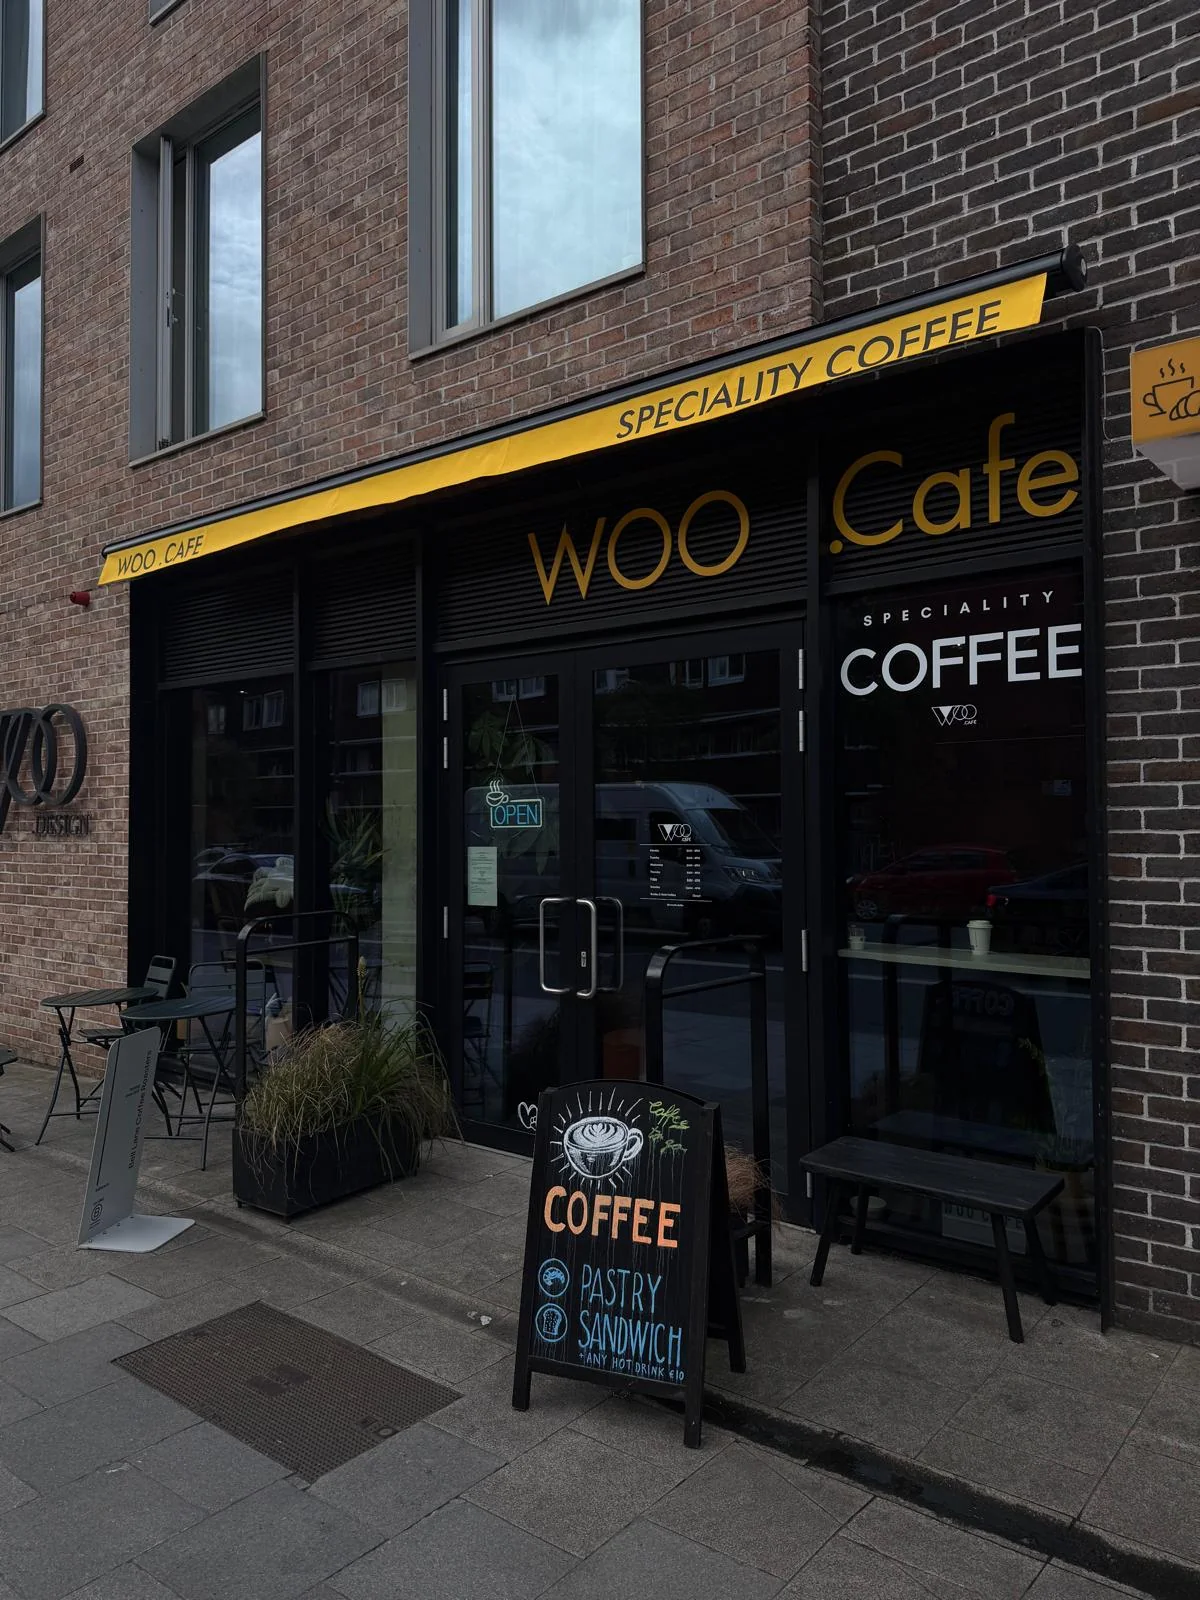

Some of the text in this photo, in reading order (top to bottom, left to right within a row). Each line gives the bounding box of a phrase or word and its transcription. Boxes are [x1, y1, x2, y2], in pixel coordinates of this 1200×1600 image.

[616, 300, 1002, 440] SPECIALITY COFFEE
[117, 549, 156, 577] WOO
[528, 489, 750, 606] WOO
[863, 590, 1055, 627] SPECIALITY
[840, 623, 1083, 696] COFFEE
[495, 804, 538, 825] OPEN
[543, 1185, 682, 1249] COFFEE
[580, 1263, 662, 1314] PASTRY
[578, 1309, 683, 1369] SANDWICH
[612, 1357, 632, 1370] HOT
[635, 1361, 665, 1378] DRINK
